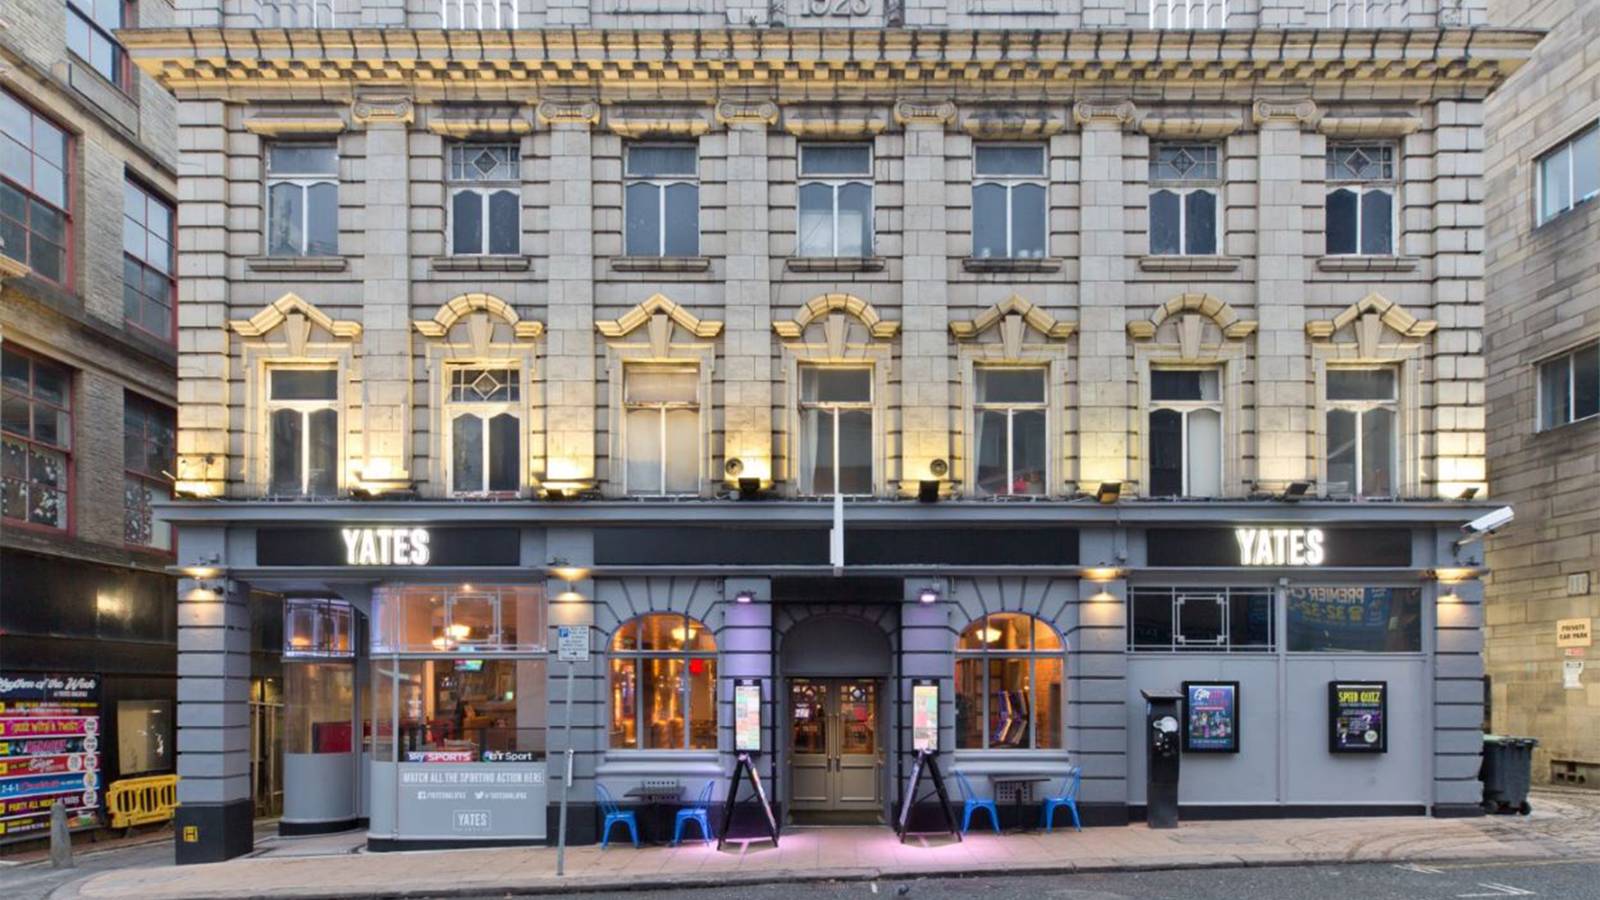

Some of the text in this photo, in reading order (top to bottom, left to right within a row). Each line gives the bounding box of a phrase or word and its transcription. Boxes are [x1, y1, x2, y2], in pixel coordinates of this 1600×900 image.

[341, 528, 430, 565] YATES
[1235, 528, 1324, 565] YATES
[1561, 624, 1585, 632] PRIVATE
[1360, 691, 1381, 703] QUIZ
[427, 751, 472, 761] SPORTS
[505, 752, 532, 761] Sport
[403, 772, 542, 783] WATCH ALL THE SPORTING ACTION HERE
[457, 812, 488, 827] YATES
